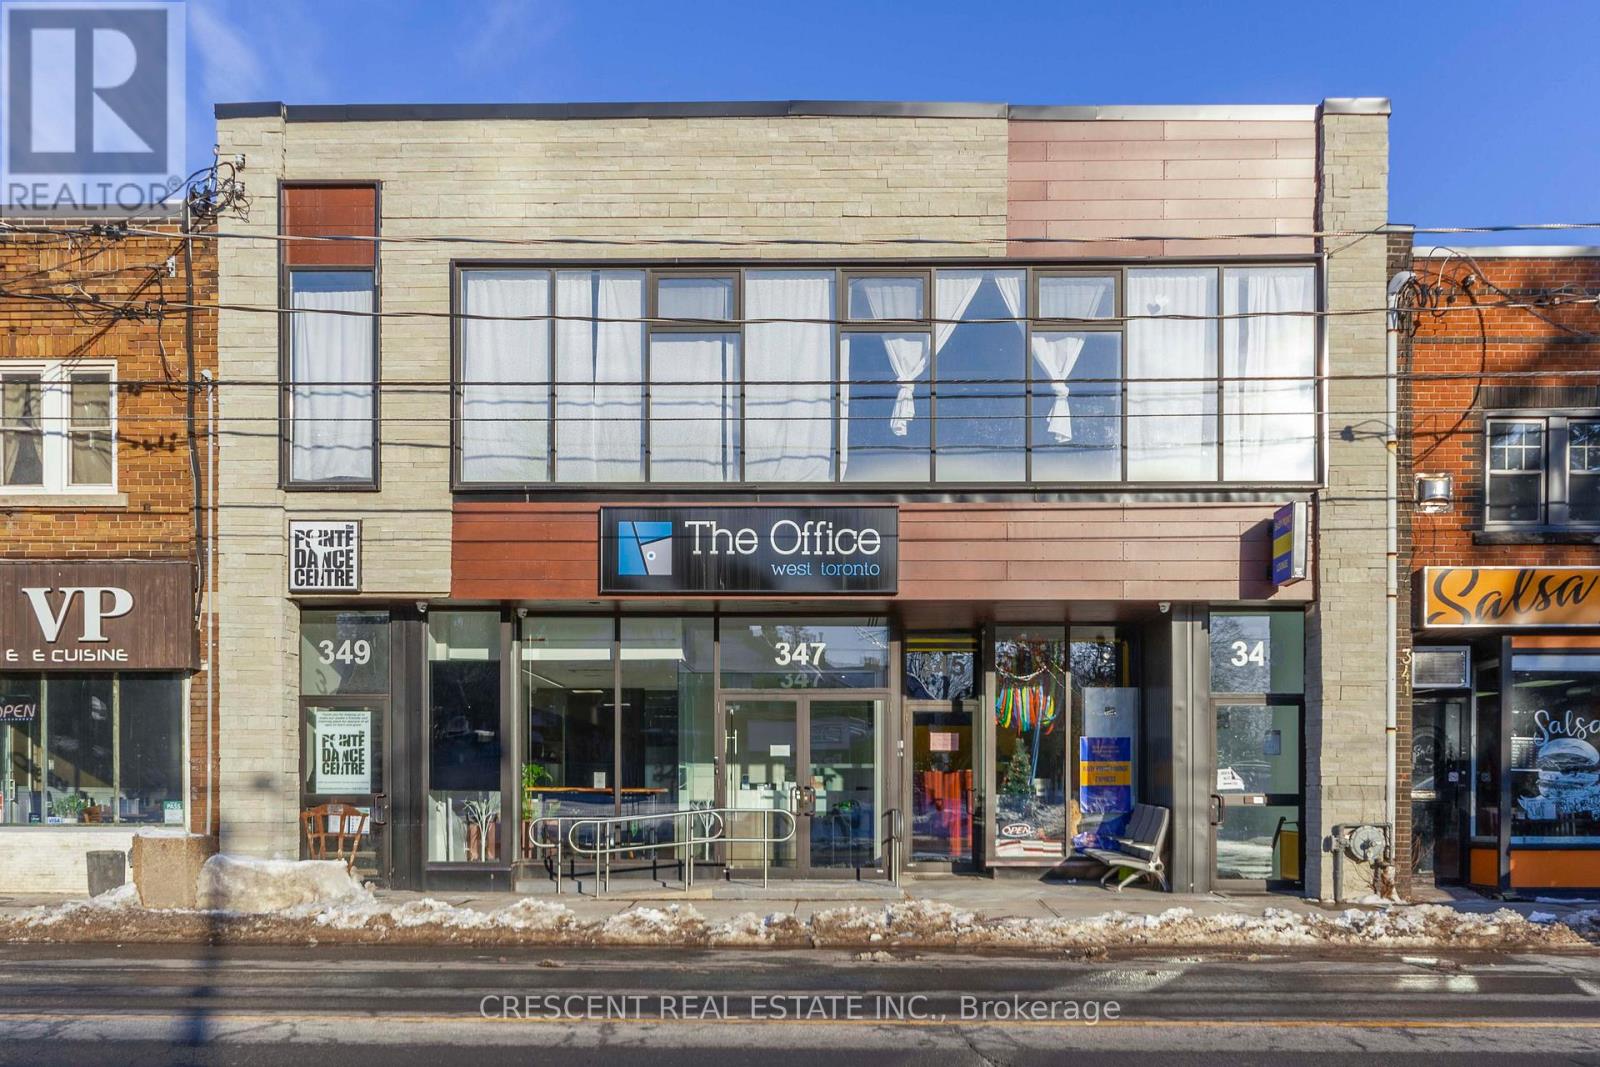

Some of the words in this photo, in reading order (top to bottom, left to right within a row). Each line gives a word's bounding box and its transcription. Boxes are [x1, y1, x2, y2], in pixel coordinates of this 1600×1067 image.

[684, 520, 758, 555] The
[770, 519, 881, 555] Office
[294, 548, 354, 569] DANCE
[294, 568, 354, 586] CENTRE
[770, 562, 812, 576] west
[821, 562, 881, 576] toronto
[21, 586, 134, 643] VP
[51, 648, 129, 662] CUISINE
[319, 639, 371, 665] 349
[774, 642, 827, 666] 347
[0, 704, 36, 718] PEN
[322, 748, 365, 763] DANCE
[1003, 825, 1030, 835] OPEN
